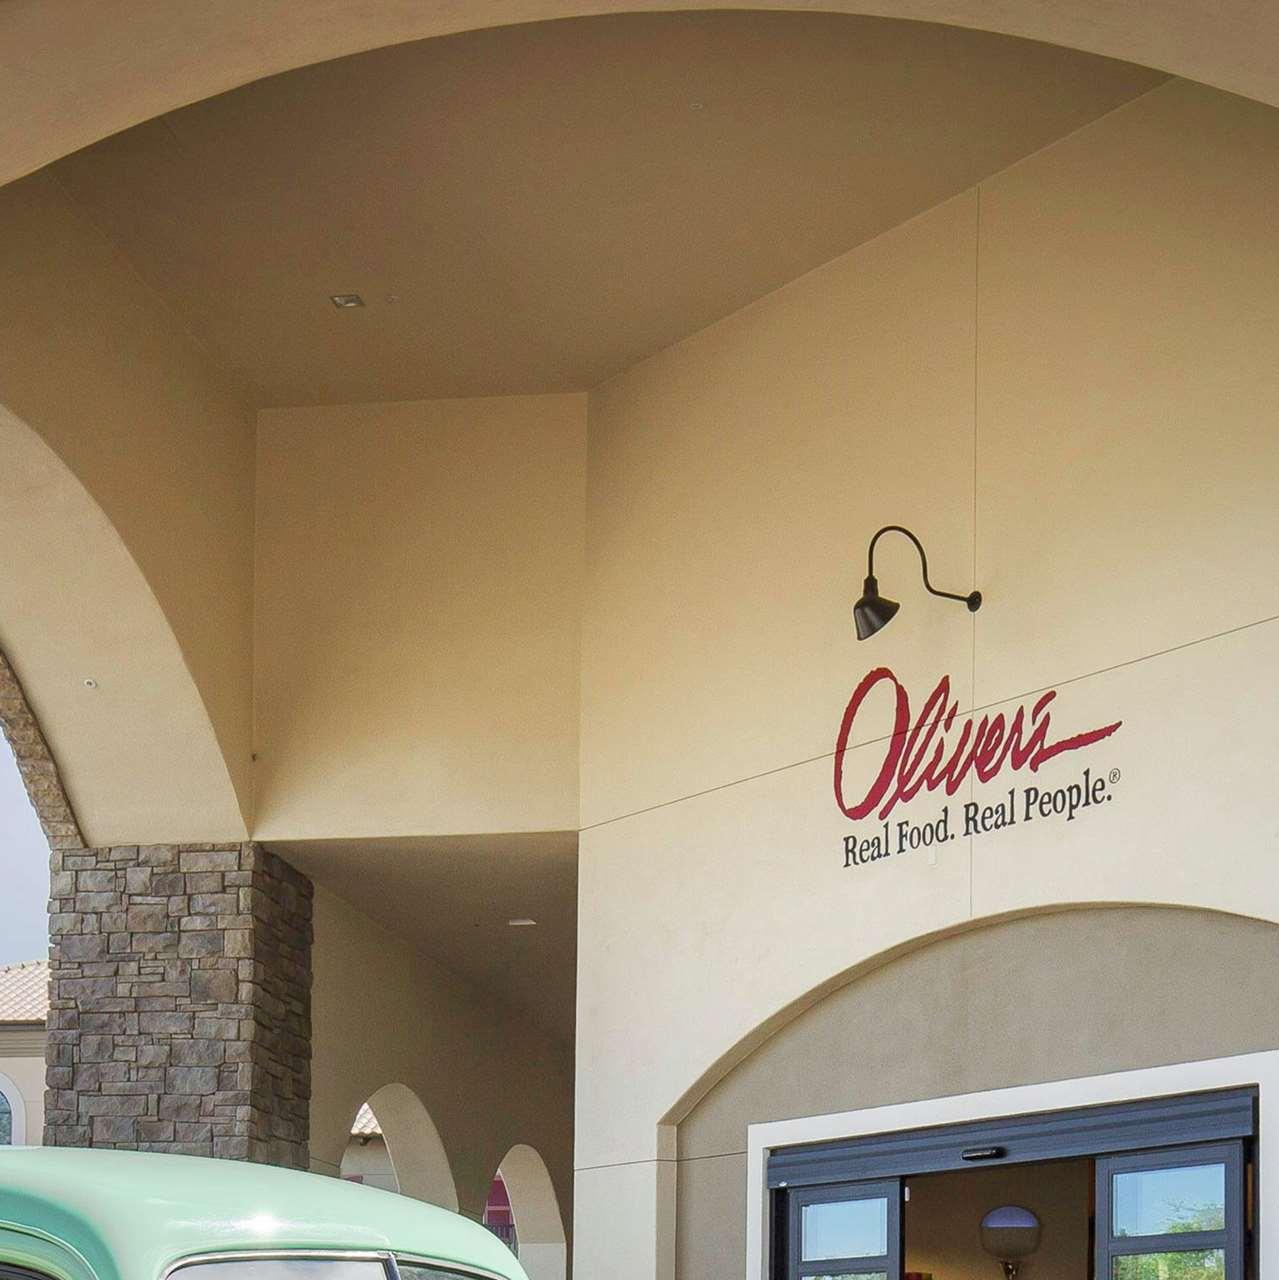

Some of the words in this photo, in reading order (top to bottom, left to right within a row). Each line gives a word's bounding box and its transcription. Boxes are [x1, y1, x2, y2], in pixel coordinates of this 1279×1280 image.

[834, 667, 1122, 820] Oliver's
[843, 821, 890, 867] Real
[897, 806, 955, 854] Food.
[963, 788, 1015, 836] Real
